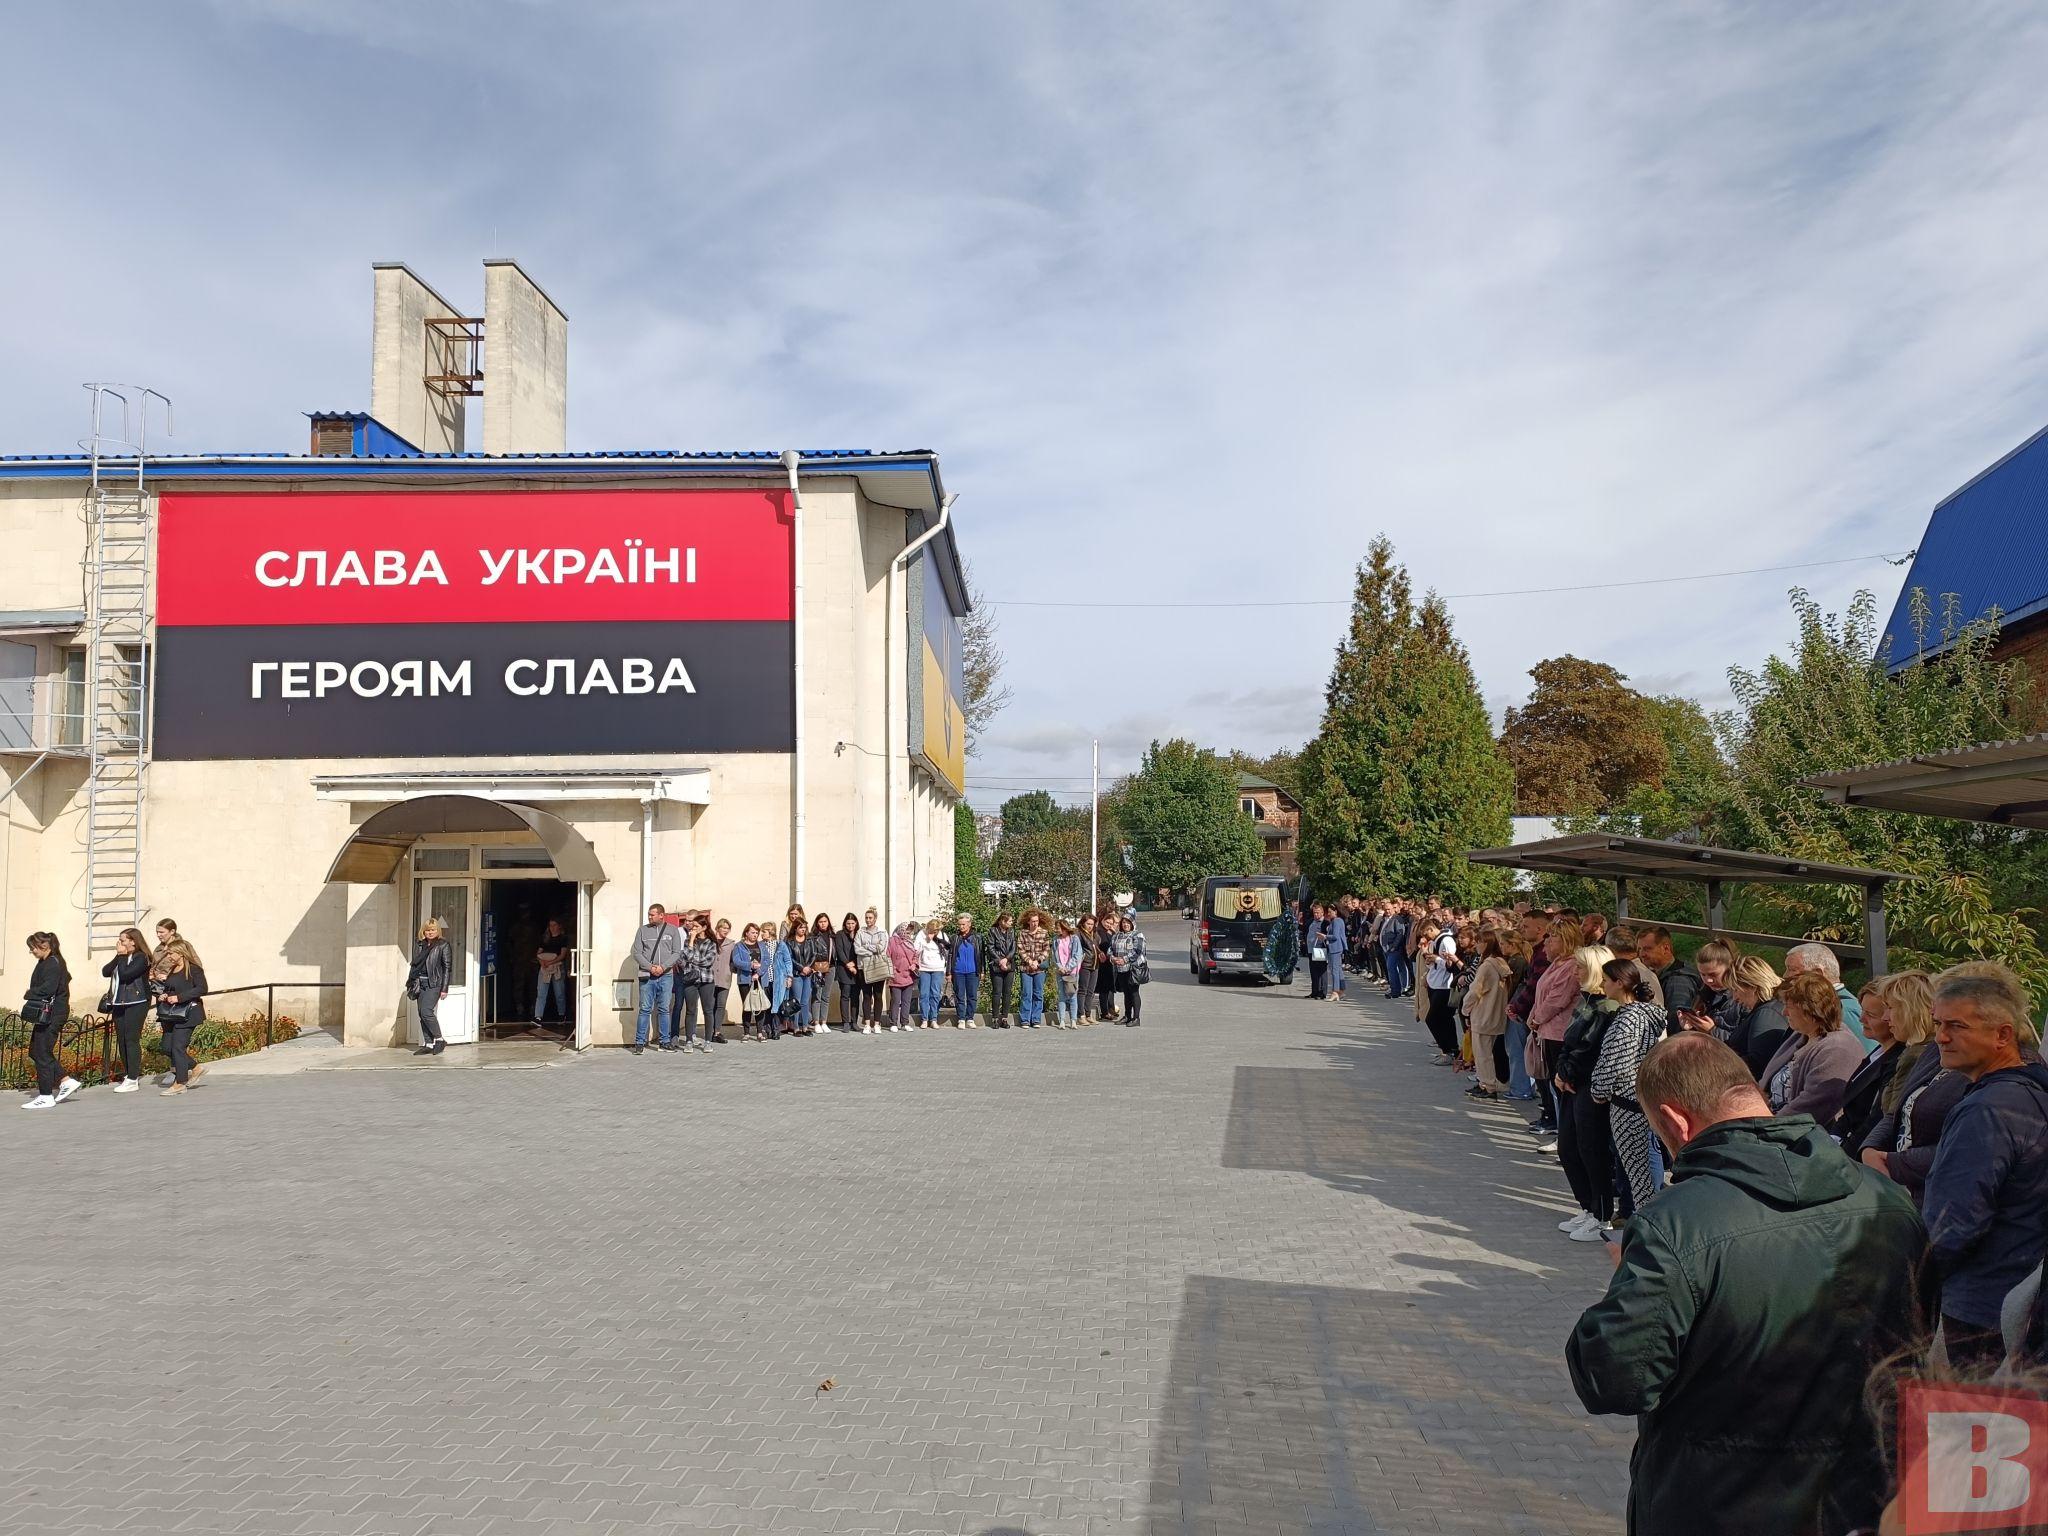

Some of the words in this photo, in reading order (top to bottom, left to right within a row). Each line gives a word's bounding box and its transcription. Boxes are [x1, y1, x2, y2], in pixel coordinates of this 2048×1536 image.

[254, 549, 450, 588] СЛАВА
[478, 538, 698, 586] УКРАЇНІ
[250, 659, 473, 699] ГЕРОЯМ
[503, 657, 697, 696] СЛАВА
